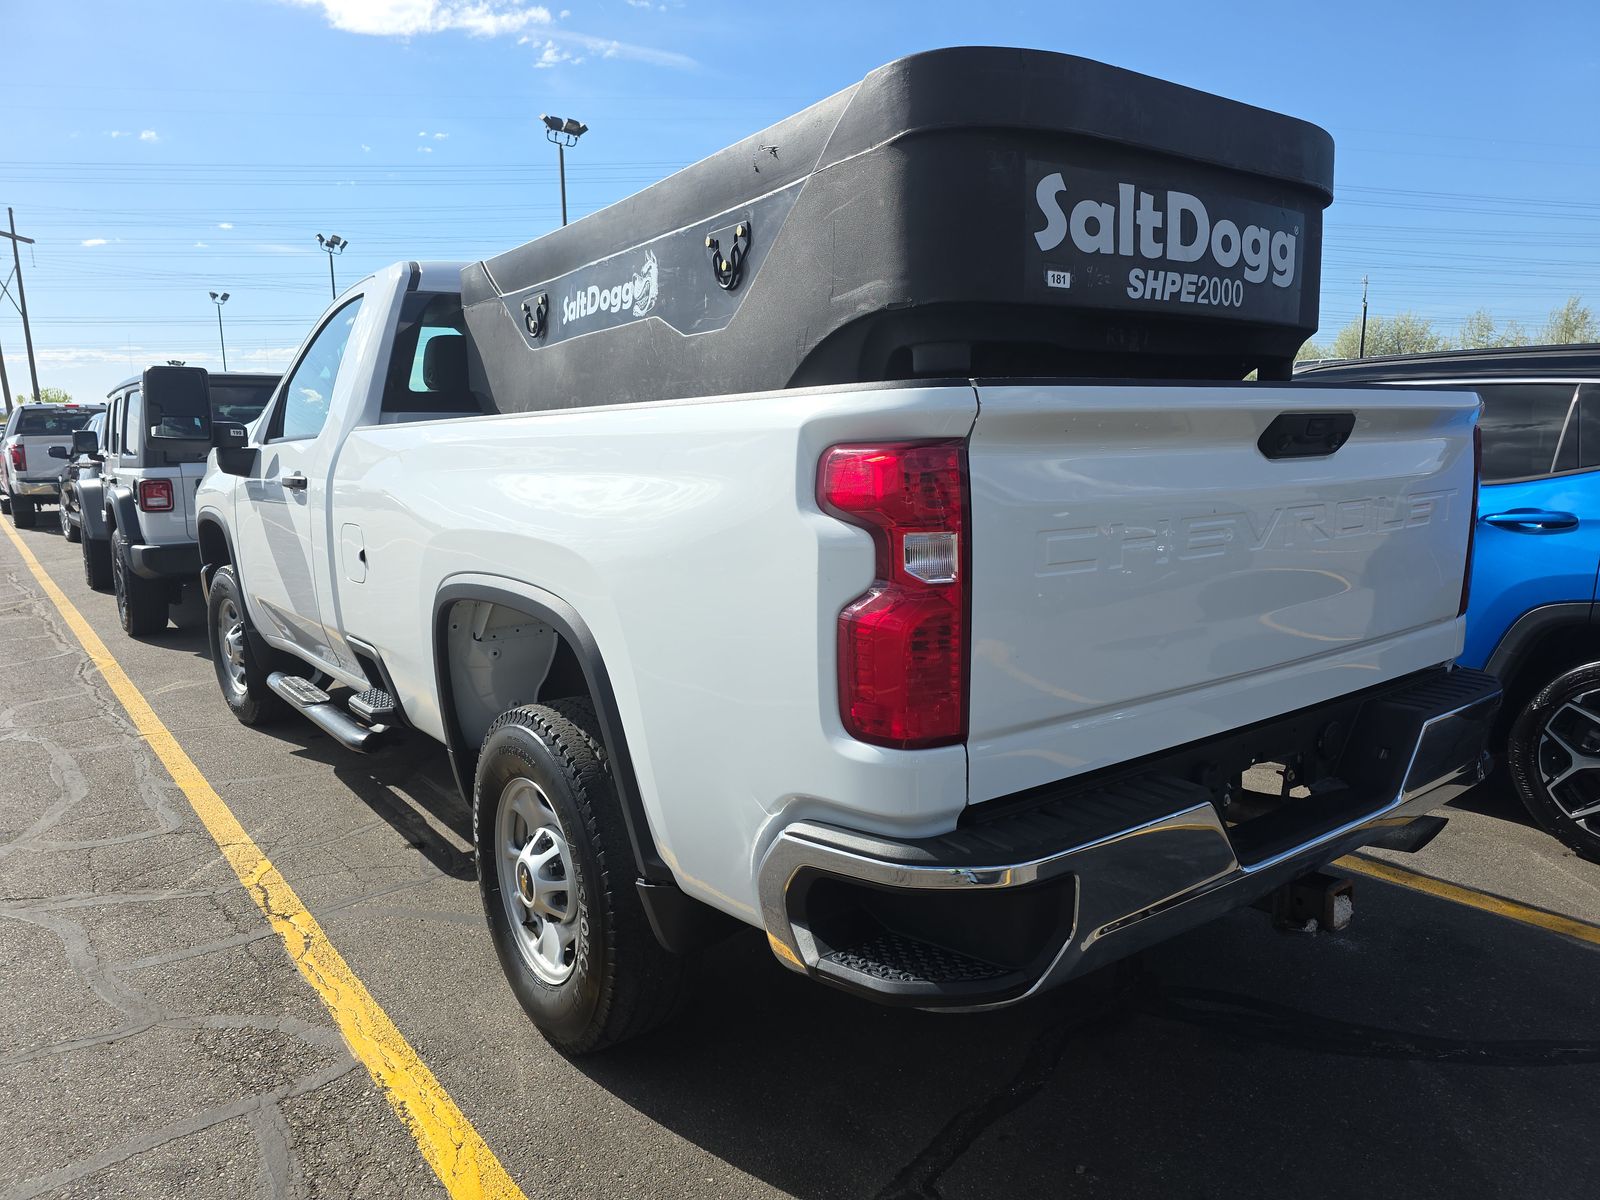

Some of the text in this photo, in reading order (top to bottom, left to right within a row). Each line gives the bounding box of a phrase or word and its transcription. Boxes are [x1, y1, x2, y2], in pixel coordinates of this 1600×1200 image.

[1034, 172, 1297, 287] SaltDogg
[1051, 273, 1067, 285] 181
[1127, 268, 1243, 307] SHPE2000
[563, 281, 634, 325] SaltDogg
[1036, 489, 1458, 577] CHEVROLET
